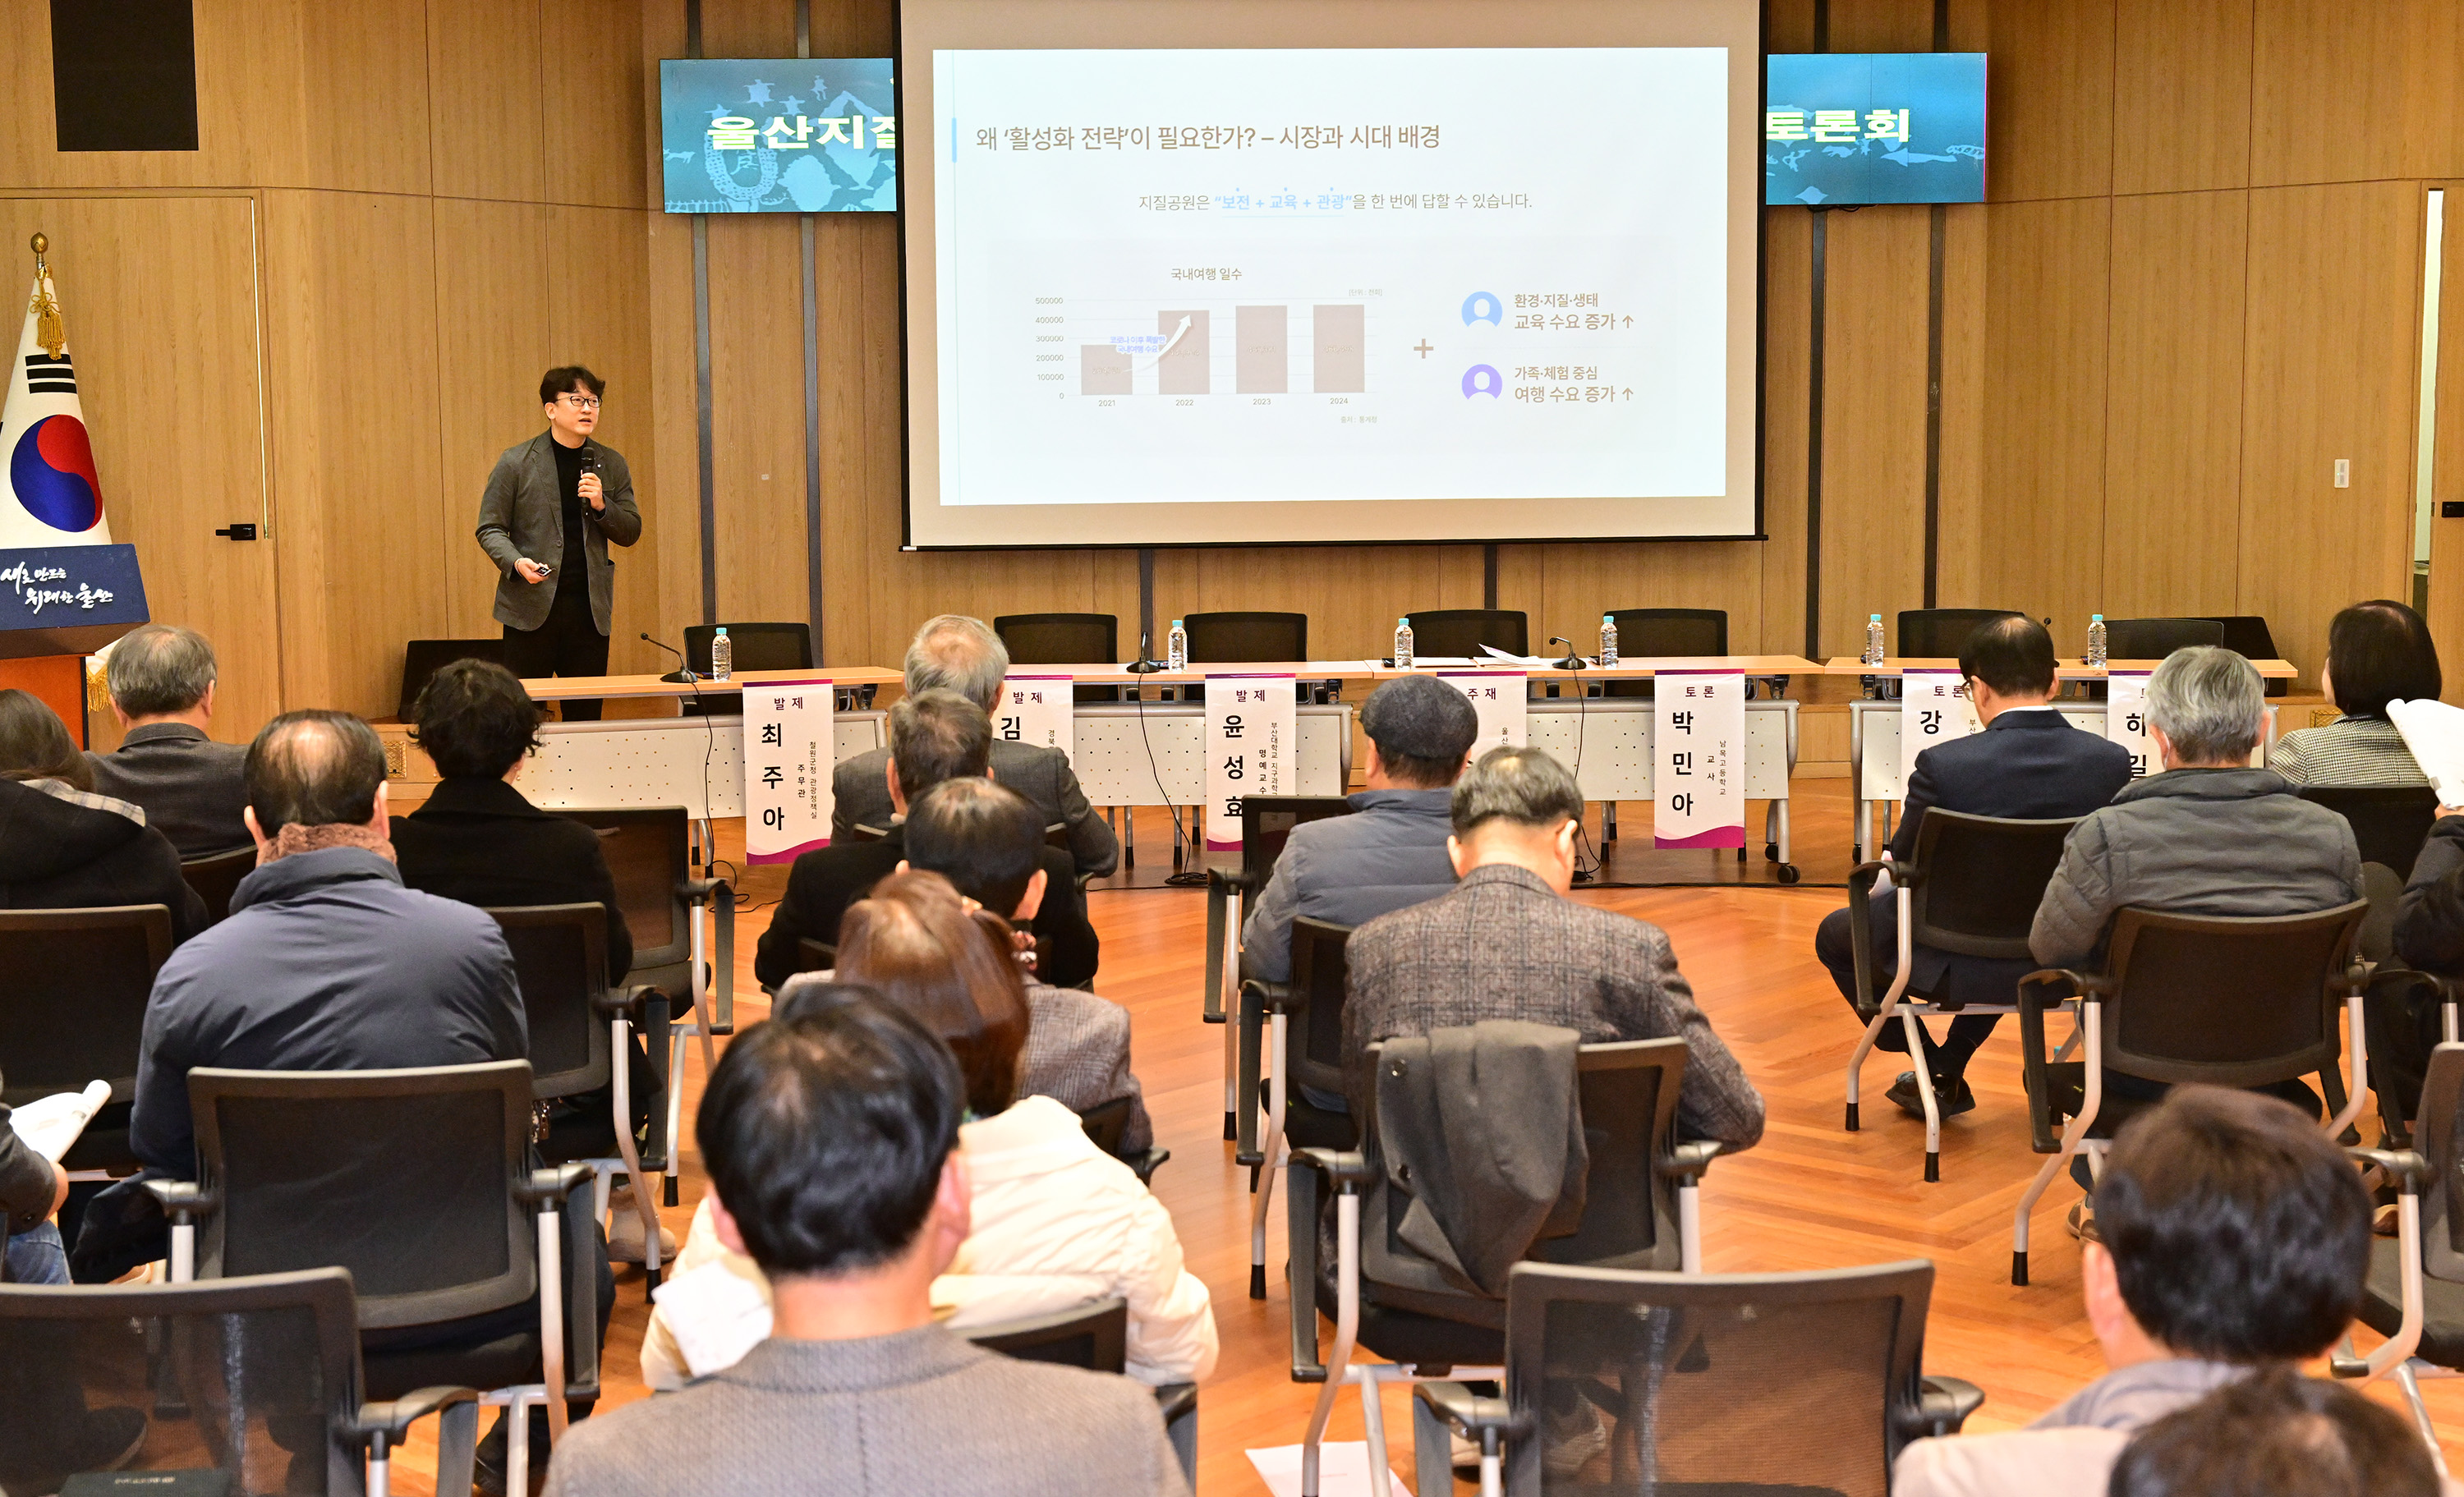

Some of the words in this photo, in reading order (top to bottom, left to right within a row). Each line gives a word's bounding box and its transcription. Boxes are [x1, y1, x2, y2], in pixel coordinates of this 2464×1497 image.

[977, 127, 996, 150] 왜
[1158, 126, 1256, 149] 필요한가?
[1280, 126, 1344, 149] 시장과
[1350, 125, 1391, 149] 시대
[1398, 125, 1440, 149] 배경
[1766, 109, 1910, 142] 토론회
[1139, 195, 1210, 210] 지질공원은
[1269, 194, 1298, 209] 교육
[1371, 194, 1386, 209] 한
[1390, 194, 1417, 209] 번에
[1422, 194, 1450, 209] 답할
[1455, 195, 1469, 209] 수
[1473, 193, 1533, 209] 있습니다.
[1170, 267, 1216, 282] 국내여행
[1220, 267, 1242, 281] 일수
[1514, 314, 1545, 330] 교육
[1550, 314, 1580, 330] 수요
[1584, 313, 1616, 330] 증가
[1036, 354, 1064, 362] 200000
[1572, 365, 1597, 380] 중심
[1514, 386, 1545, 403] 여행
[1550, 386, 1580, 403] 수요
[1584, 385, 1616, 402] 증가
[76, 583, 113, 608] 울산
[1920, 710, 1942, 734] 강
[1223, 714, 1245, 817] 윤성효
[1671, 711, 1694, 816] 박민아
[761, 723, 784, 830] 최주아
